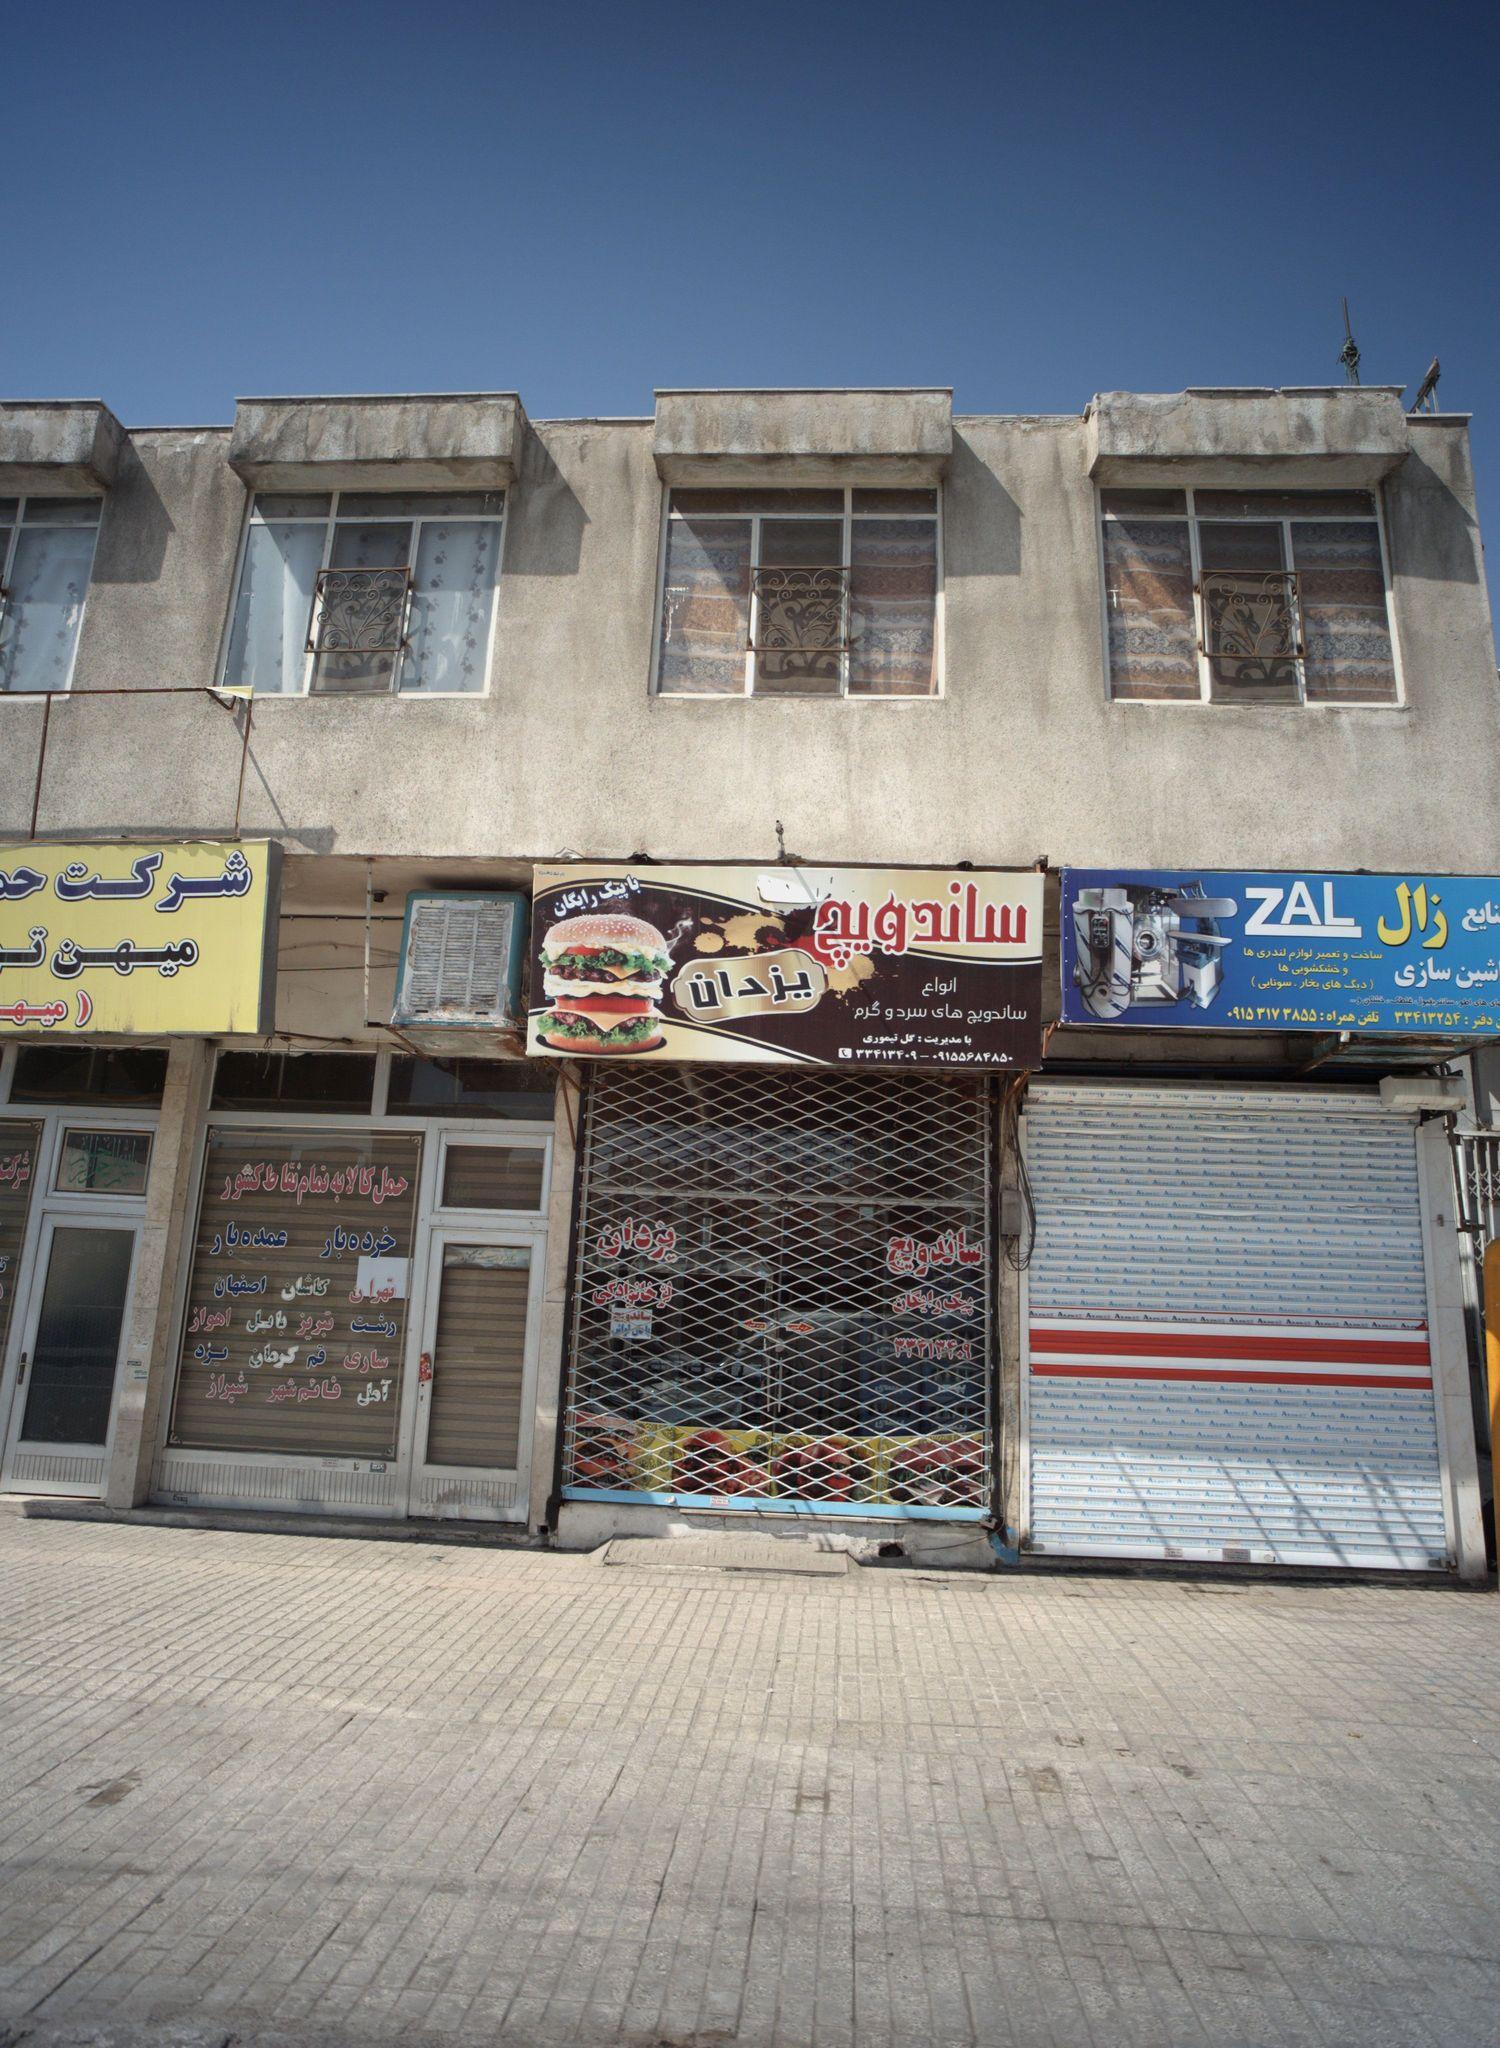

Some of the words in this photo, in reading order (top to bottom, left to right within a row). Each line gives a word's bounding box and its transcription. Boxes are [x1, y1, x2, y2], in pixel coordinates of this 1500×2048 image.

[55, 850, 253, 913] شرکت
[598, 880, 629, 900] پیک
[554, 888, 599, 918] رایگان
[1244, 880, 1363, 938] ZAL
[1377, 881, 1449, 949] زال
[1461, 900, 1500, 932] نایع
[814, 882, 1028, 970] ساندویچ
[51, 938, 199, 979] میهن
[1288, 948, 1312, 962] لوازم
[1350, 951, 1383, 961] ساخت
[921, 976, 957, 996] انواع
[1394, 956, 1451, 989] سازی
[688, 964, 814, 1010] یزدان
[0, 1000, 68, 1027] میه
[853, 1000, 881, 1020] گرم
[896, 1009, 927, 1021] سرد
[931, 1004, 963, 1020] های
[966, 1005, 1027, 1024] ساندویچ
[862, 1033, 898, 1044] تیموری
[924, 1033, 961, 1045] مدیریت
[856, 1048, 917, 1060] ۳۳۴۱۳۴۰۹
[933, 1049, 1013, 1062] ۰۹۱۵۵۶۸۴۸۵۰
[220, 1163, 265, 1200] کشور
[346, 1164, 374, 1195] کالا
[372, 1166, 409, 1204] حمل
[886, 1226, 984, 1277] ساندویچ
[214, 1273, 267, 1297] اصفهان
[188, 1306, 232, 1333] اهواز
[296, 1310, 335, 1341] تبریز
[350, 1312, 397, 1338] رشت
[193, 1341, 229, 1367] یزد
[306, 1344, 328, 1369] قم
[343, 1349, 389, 1374] ساری
[205, 1370, 248, 1404] شیراز
[356, 1378, 392, 1407] آمل
